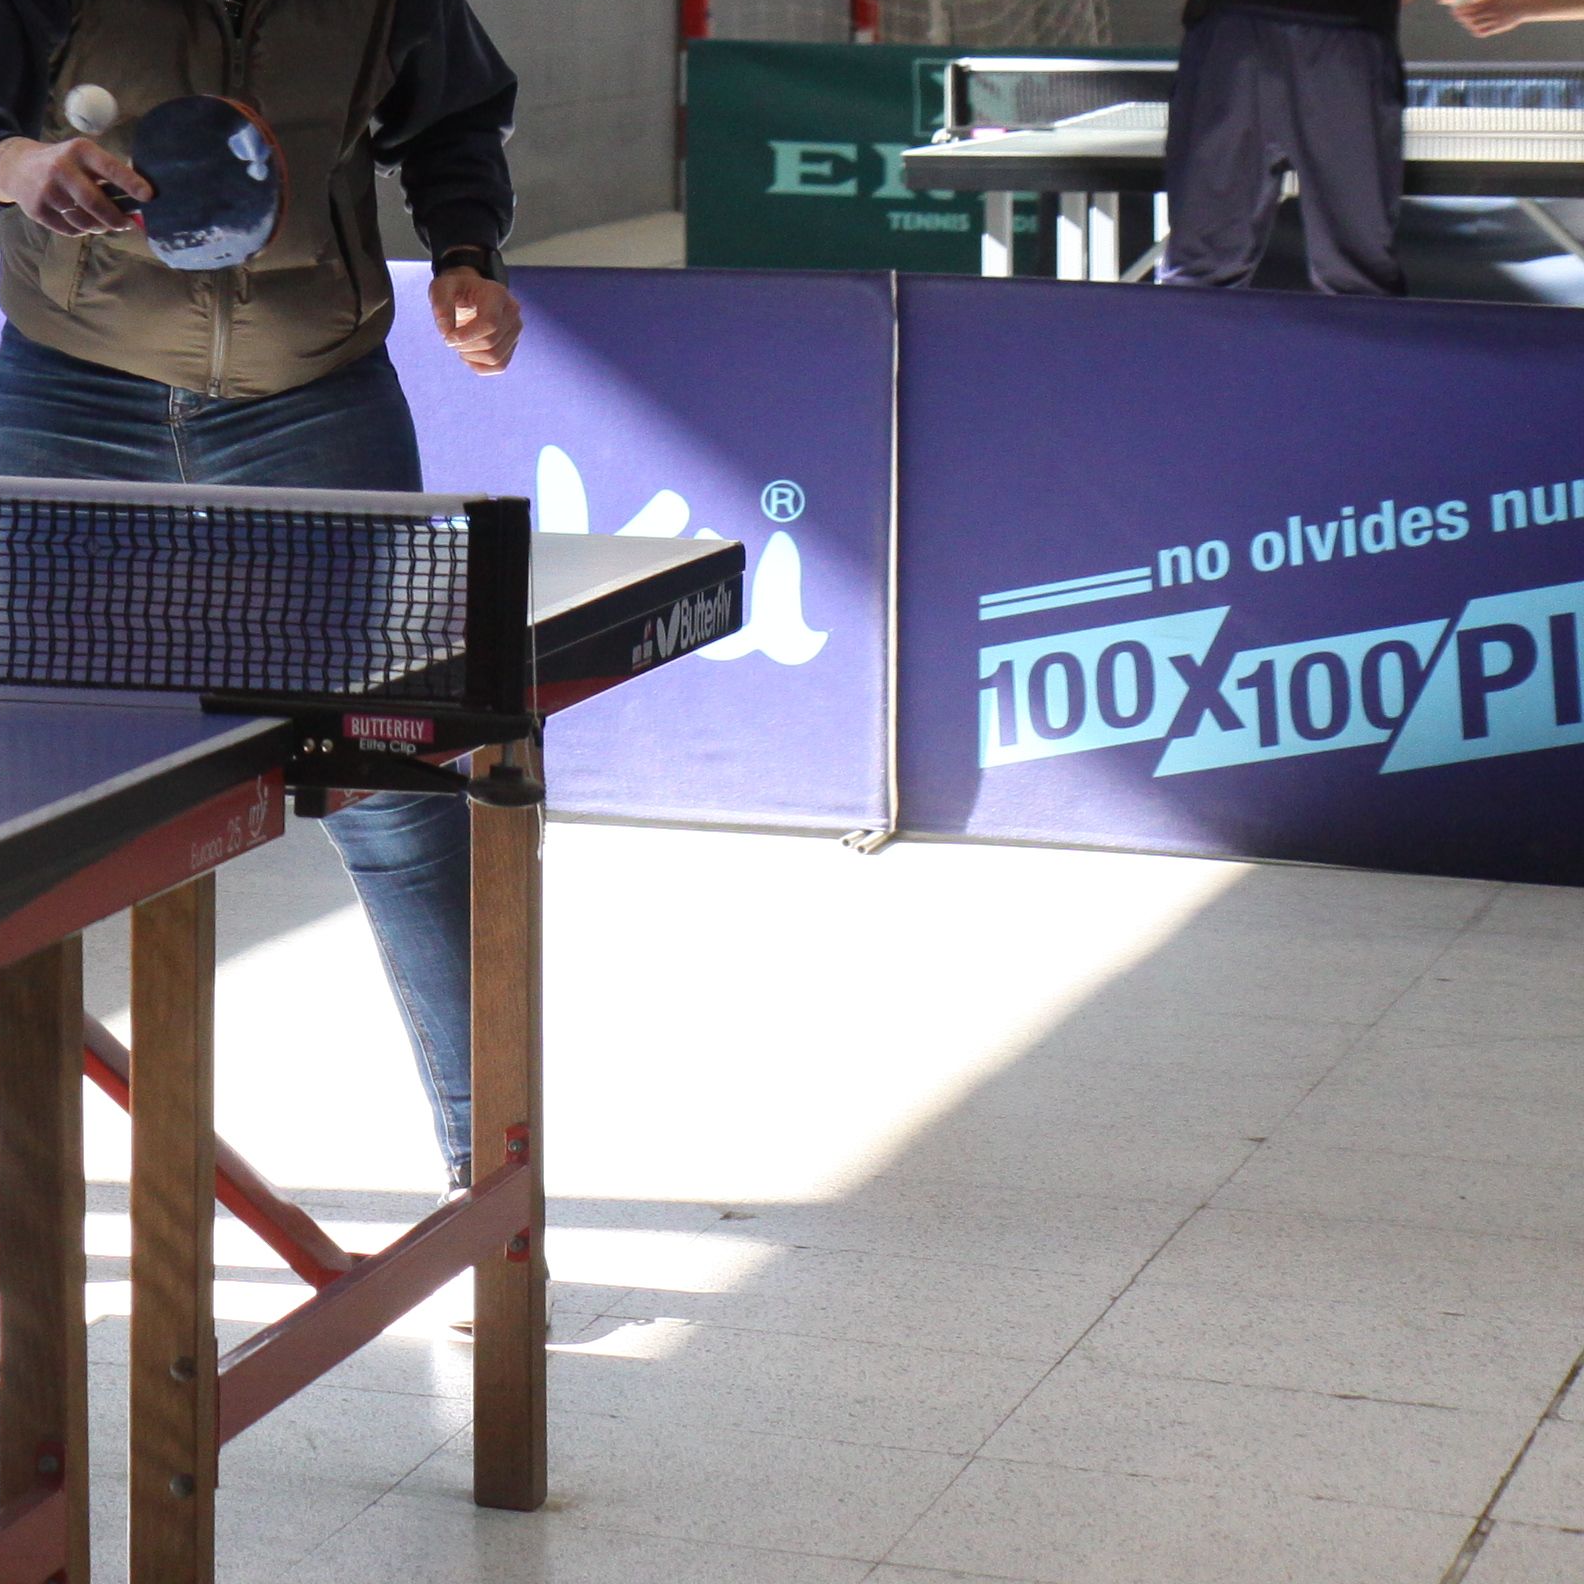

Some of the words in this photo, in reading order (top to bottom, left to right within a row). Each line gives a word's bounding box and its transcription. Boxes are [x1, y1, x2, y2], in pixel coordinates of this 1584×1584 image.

[1158, 540, 1231, 588] no
[1250, 497, 1469, 573] olvides
[1492, 478, 1584, 533] nu
[680, 581, 732, 650] Butterfly
[351, 716, 425, 741] BUTTERFLY
[359, 738, 386, 753] Elite
[389, 740, 416, 756] Clip
